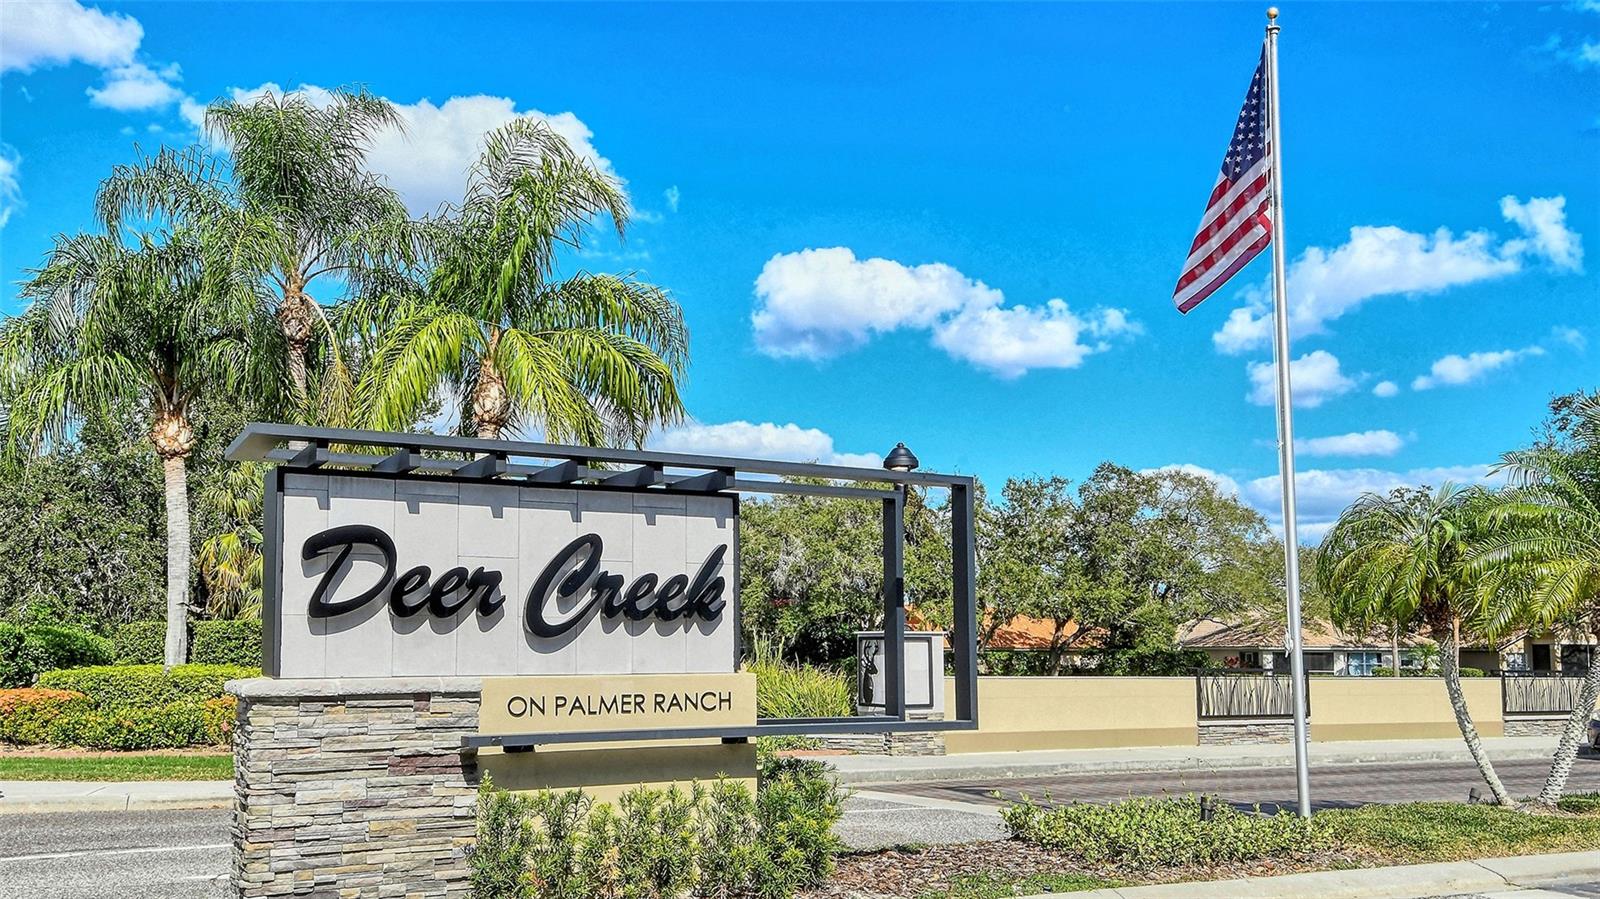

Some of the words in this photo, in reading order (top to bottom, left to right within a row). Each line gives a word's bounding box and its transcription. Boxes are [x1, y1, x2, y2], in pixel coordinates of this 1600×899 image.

[302, 524, 506, 619] Deer
[525, 533, 728, 639] Creek
[507, 695, 546, 718] ON
[554, 693, 646, 716] PALMER
[653, 691, 732, 713] RANCH
